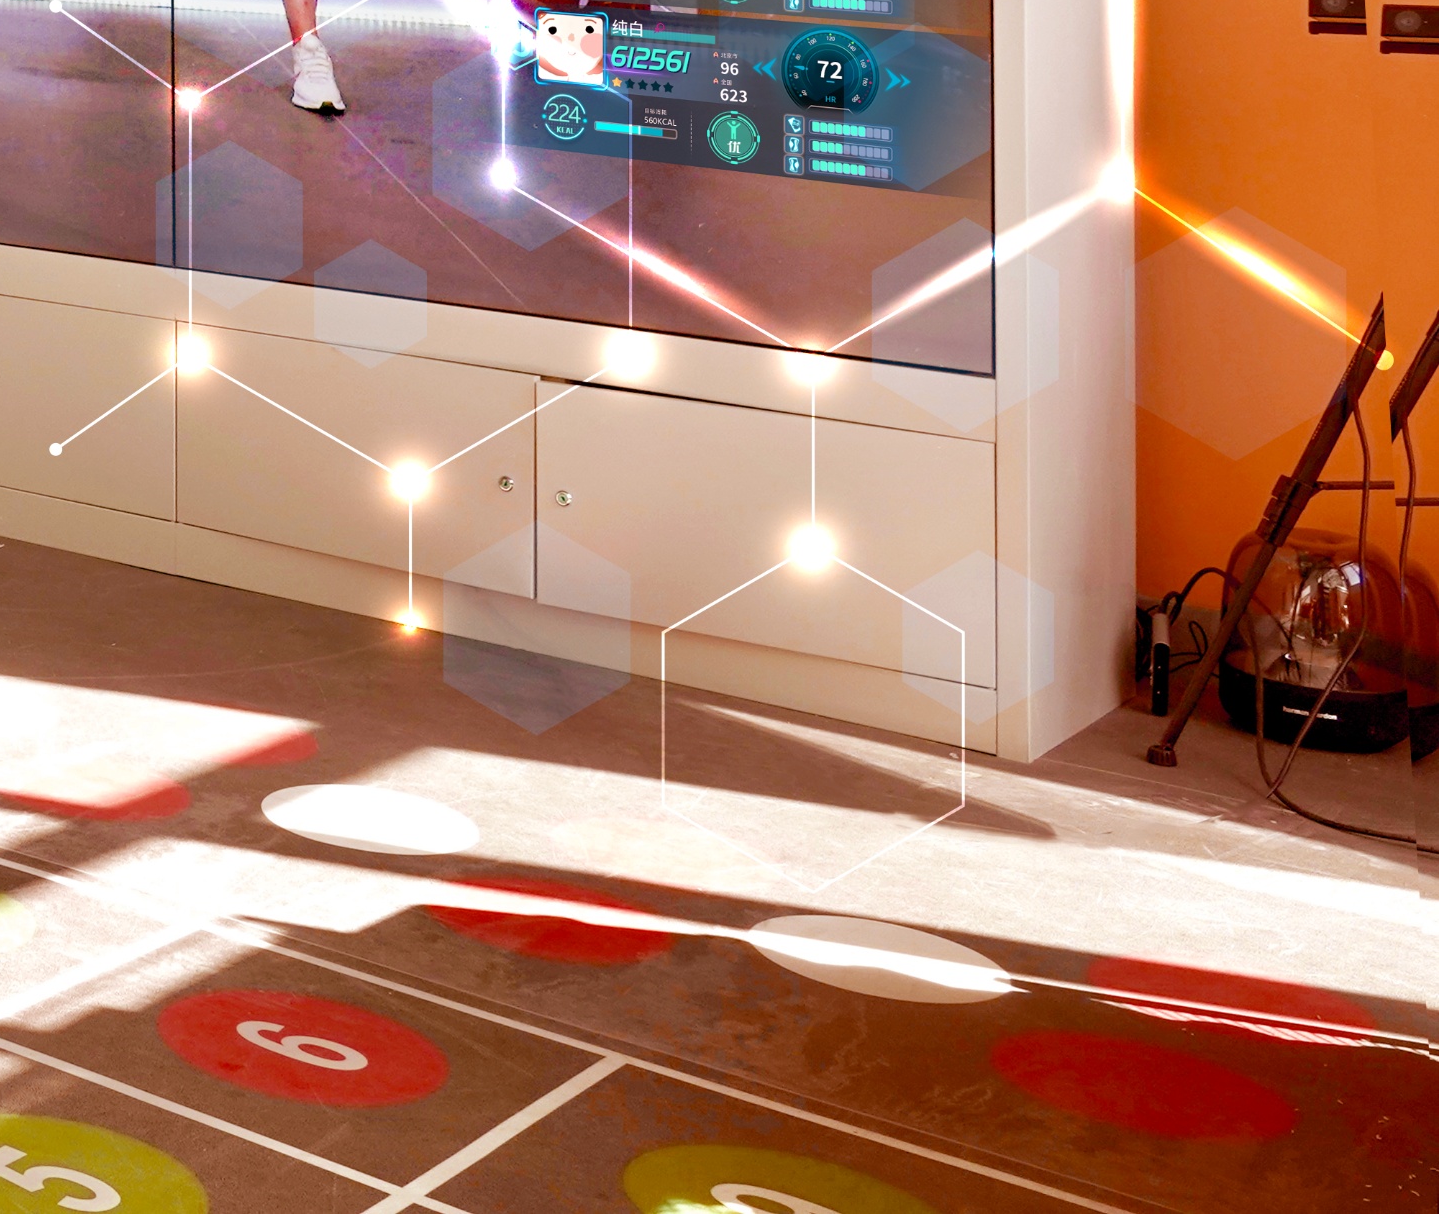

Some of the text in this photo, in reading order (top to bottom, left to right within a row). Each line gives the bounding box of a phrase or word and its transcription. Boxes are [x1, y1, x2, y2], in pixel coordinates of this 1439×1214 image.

[612, 20, 644, 38] 纯白
[610, 45, 691, 74] 612561
[721, 62, 739, 76] 96
[817, 61, 843, 80] 72
[720, 88, 748, 103] 623
[548, 103, 581, 124] 224
[644, 116, 677, 127] 560KCAL
[236, 1020, 369, 1072] 6
